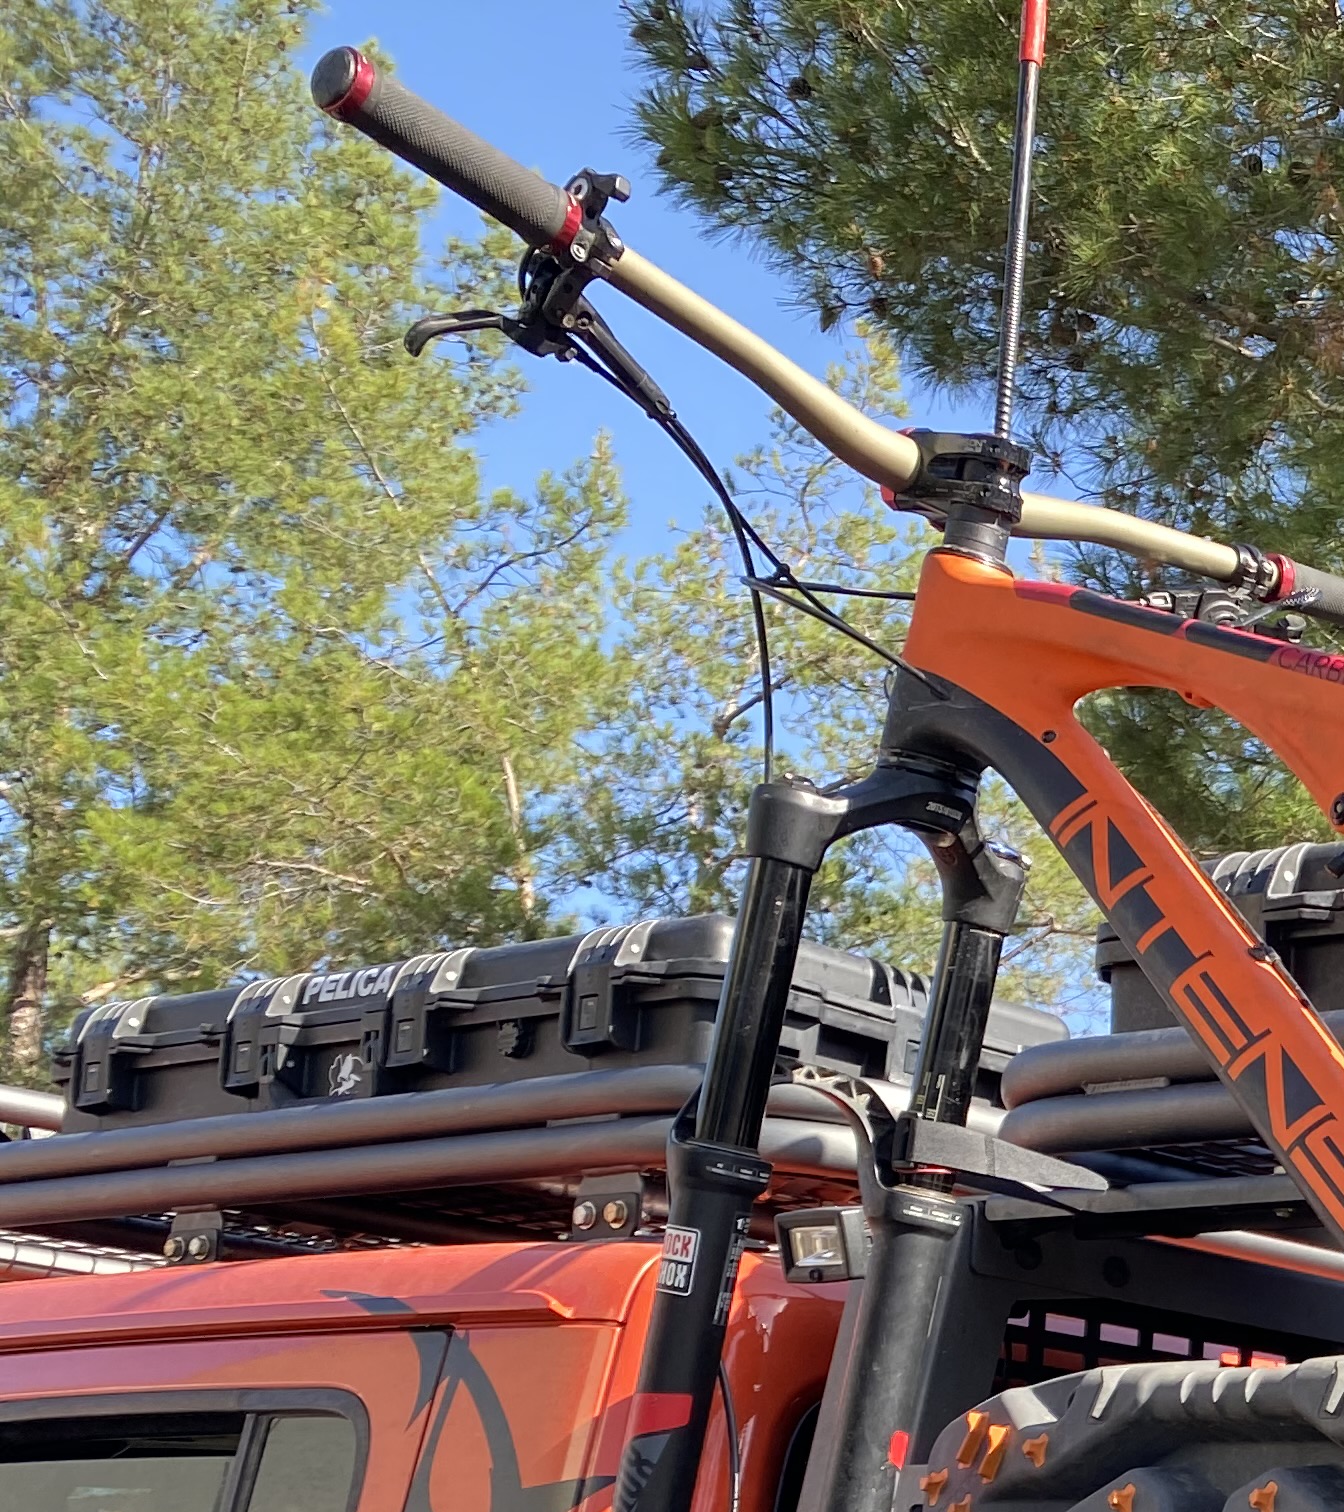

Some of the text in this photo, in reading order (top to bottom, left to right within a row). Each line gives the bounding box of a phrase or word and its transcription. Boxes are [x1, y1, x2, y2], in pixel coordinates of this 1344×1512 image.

[302, 965, 396, 1004] PELICA
[664, 1233, 692, 1258] OCK
[658, 1261, 689, 1288] HOX
